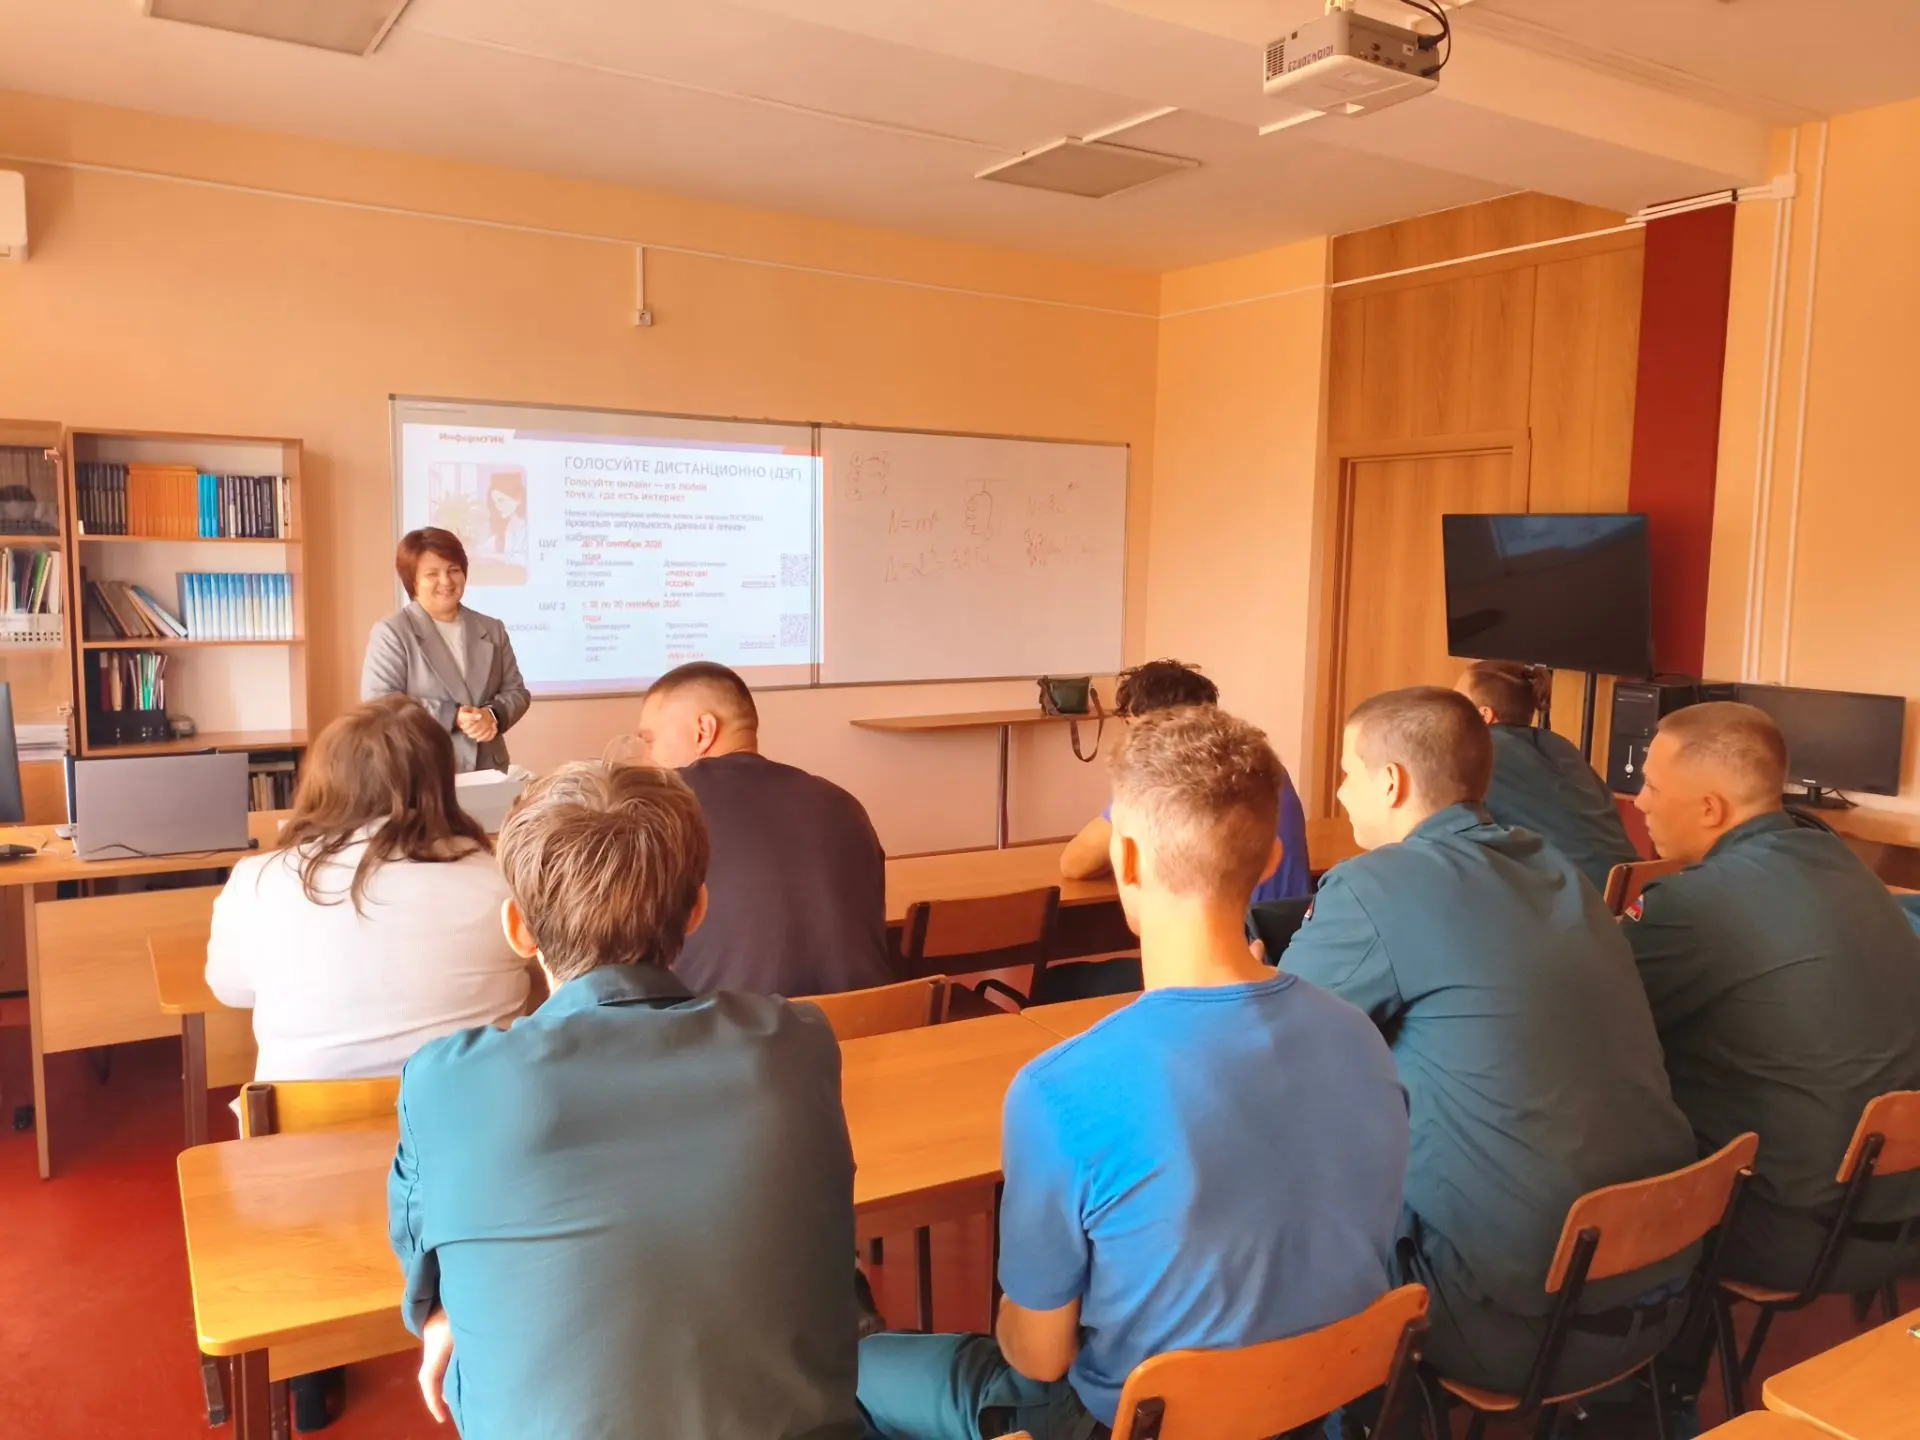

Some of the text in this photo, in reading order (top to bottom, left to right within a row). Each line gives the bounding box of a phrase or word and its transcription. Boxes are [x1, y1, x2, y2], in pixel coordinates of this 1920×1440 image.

[564, 456, 802, 481] ГОЛОСУЙТЕ ДИСТАНЦИОННО (ДЭГ)
[564, 477, 614, 490] Голосуйте
[599, 492, 615, 502] где
[617, 492, 639, 501] есть
